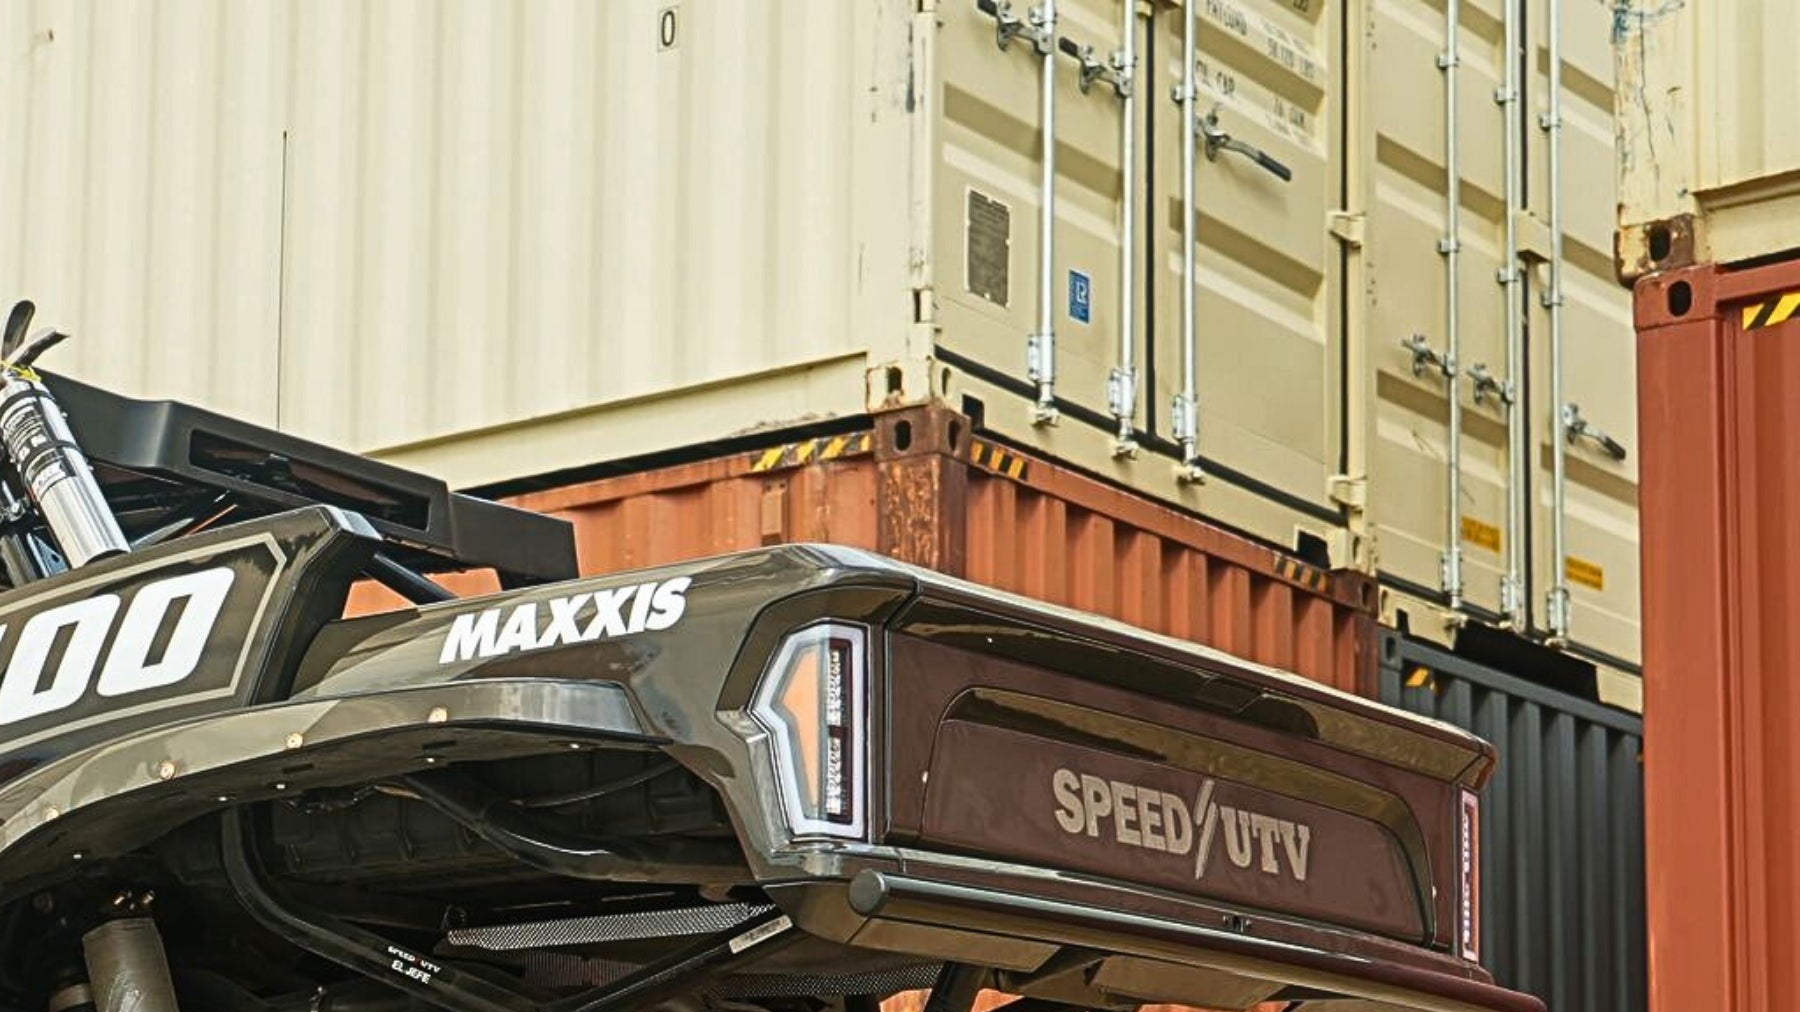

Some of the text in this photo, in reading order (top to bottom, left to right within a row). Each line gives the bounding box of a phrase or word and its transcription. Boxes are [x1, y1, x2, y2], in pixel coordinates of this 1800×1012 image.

[439, 576, 692, 664] MAXXIS
[1053, 768, 1310, 880] SPEED UTV
